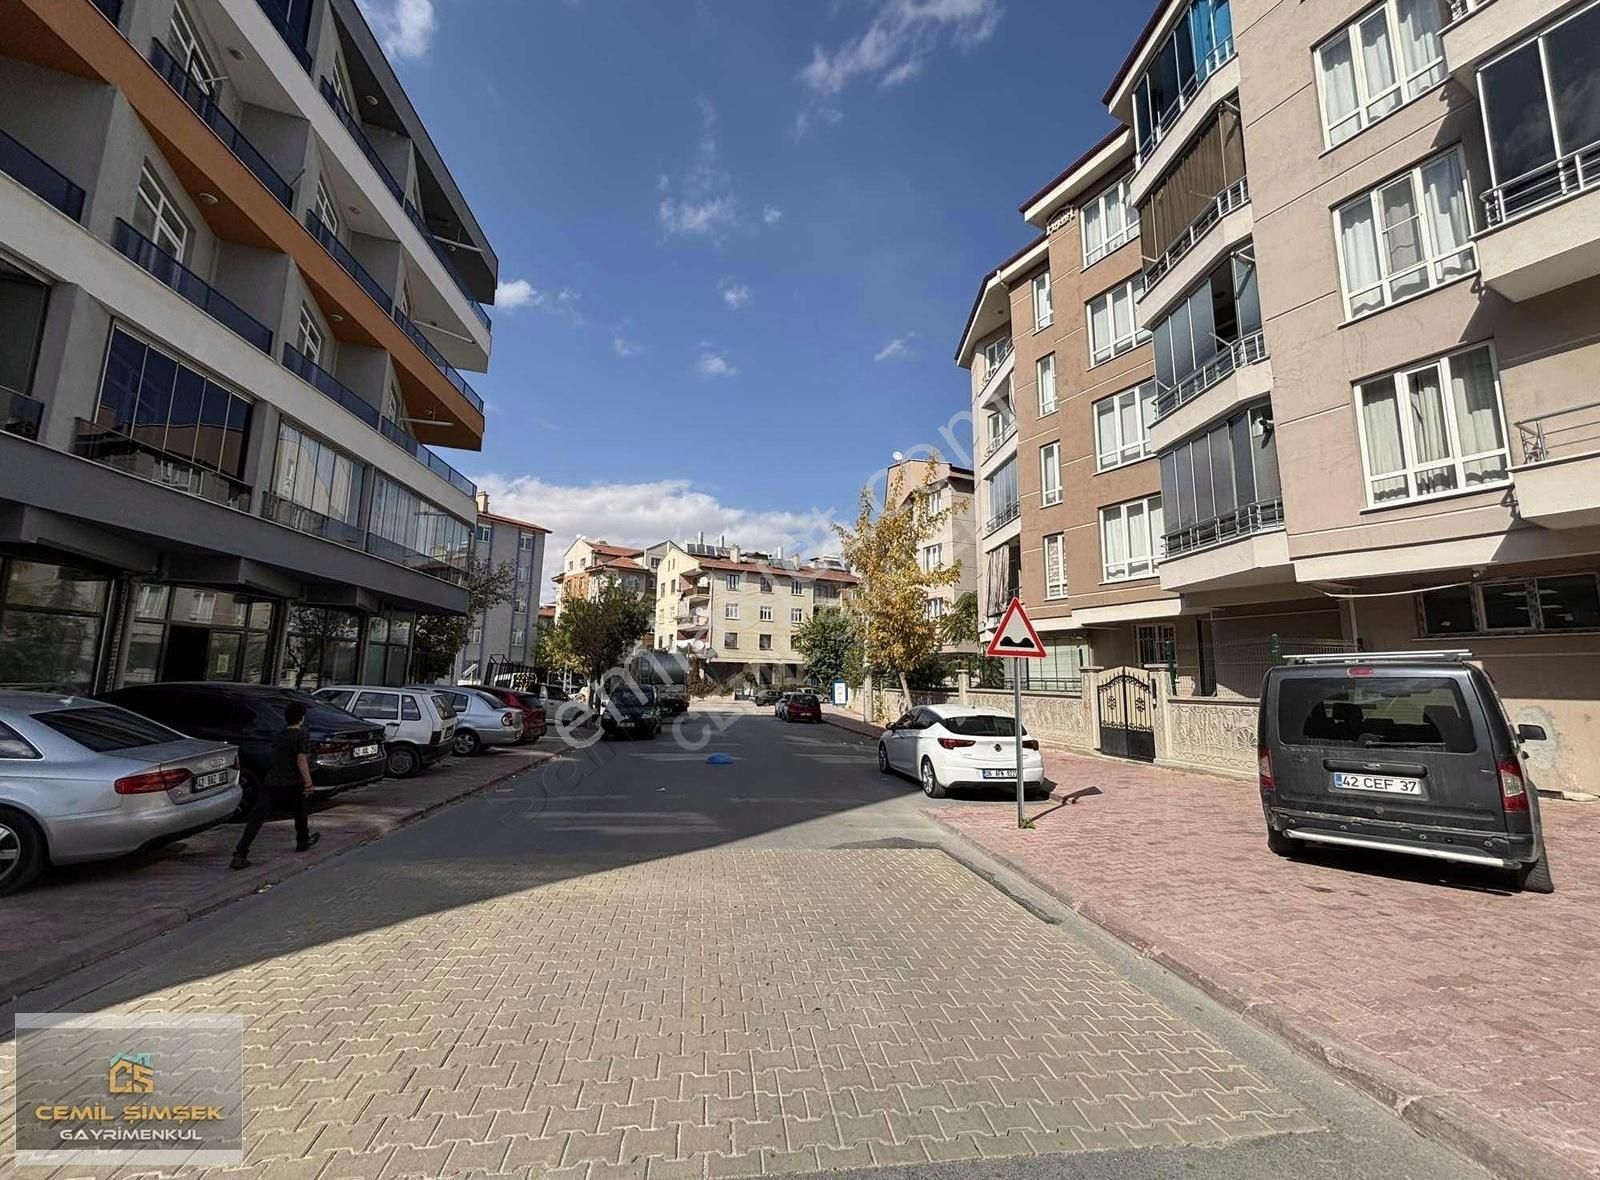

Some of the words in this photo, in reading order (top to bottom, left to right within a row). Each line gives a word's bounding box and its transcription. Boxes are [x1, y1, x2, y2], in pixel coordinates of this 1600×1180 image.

[1343, 776, 1359, 787] 42
[1363, 778, 1393, 790] CEF
[1400, 780, 1417, 792] 37
